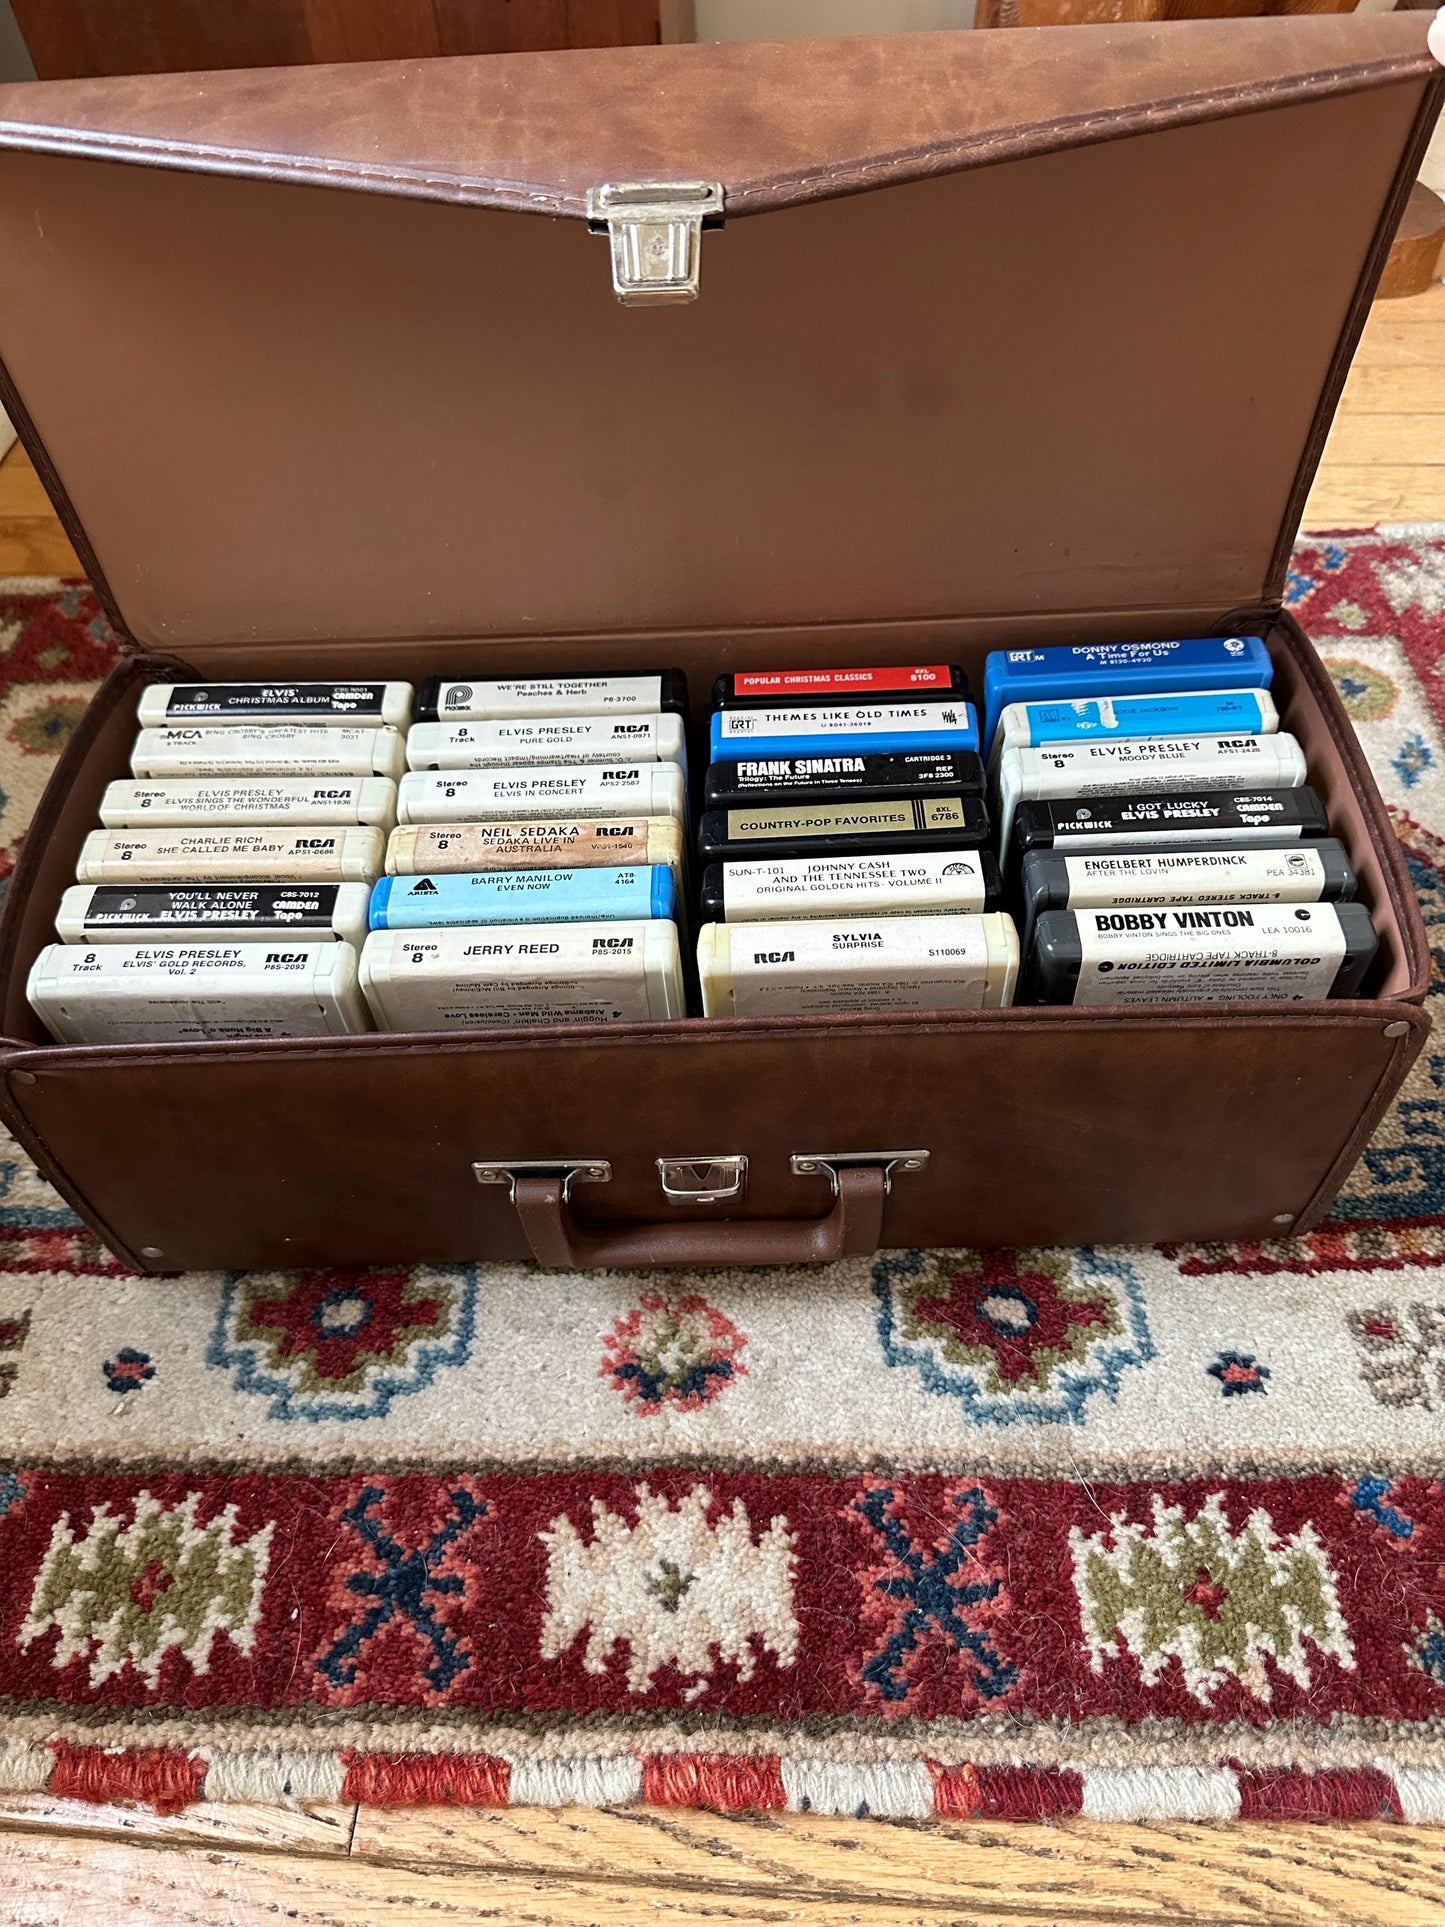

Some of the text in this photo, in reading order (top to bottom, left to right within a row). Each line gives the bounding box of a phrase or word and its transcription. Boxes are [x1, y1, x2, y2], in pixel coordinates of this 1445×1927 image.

[1072, 642, 1180, 654] DONNY OSMOND
[1131, 650, 1150, 658] For
[744, 673, 873, 685] POPULAR CHRISTMAS CLASSICS
[910, 673, 936, 681] 8100
[229, 696, 289, 704] CHRISTMAS
[332, 701, 357, 710] Tape
[765, 709, 927, 722] THEMES LIKE OLD TIMES
[499, 726, 592, 736] ELVIS PRESLEY
[614, 725, 649, 733] RCA
[1217, 740, 1257, 748] RCA
[1090, 742, 1200, 756] ELVIS PRESLEY
[1042, 752, 1074, 760] Stereo
[1119, 754, 1156, 762] MOODY
[737, 758, 865, 776] FRANK SINATRA
[1054, 760, 1065, 768] 8
[602, 770, 639, 779] RCA
[493, 779, 587, 789] ELVIS PRESLEY
[233, 789, 283, 797] PRESLEY
[314, 790, 351, 799] RCA
[446, 788, 455, 797] 8
[141, 799, 152, 807] 8
[1236, 803, 1284, 812] CAMDEN
[931, 812, 959, 820] 6786
[1121, 808, 1220, 820] ELVIS PRESLEY
[740, 814, 906, 830] COUNTRY-POP FAVORITES
[1240, 814, 1270, 826] Tape
[1058, 821, 1112, 830] PICKWICK
[481, 826, 580, 837] NEIL SEDAKA
[596, 826, 633, 836] RCA
[181, 837, 232, 845] CHARLIE
[295, 839, 334, 848] RCA
[438, 840, 448, 849] 8
[483, 837, 530, 845] SEDAKA
[496, 845, 561, 853] AUSTRALIA
[121, 851, 132, 860] 8
[808, 862, 890, 873] JOHNNY CASH
[1084, 856, 1247, 870] ENGELBERT HUMPERDINCK
[729, 868, 784, 876] SUN-T-101
[1288, 868, 1315, 876] 34381
[471, 873, 573, 885] BARRY MANILOW
[772, 876, 798, 884] AND
[828, 871, 896, 880] TENNESSEE
[497, 884, 523, 892] EVEN
[756, 884, 808, 893] ORIGINAL
[888, 878, 932, 886] VOLUME
[169, 892, 213, 900] YOU'LL
[172, 901, 252, 909] WALK ALONE
[272, 900, 319, 909] CAMDEN
[160, 910, 259, 920] ELVIS PRESLEY
[274, 911, 303, 922] Tape
[1095, 911, 1254, 930] BOBBY VINTON
[1283, 926, 1312, 934] 10016
[833, 933, 882, 941] SYLVIA
[593, 938, 633, 947] RCA
[832, 941, 884, 949] SURPRISE
[463, 944, 560, 955] JERRY REED
[929, 948, 965, 956] S110069
[1235, 950, 1277, 958] 8-TRACK
[84, 954, 96, 963] 8
[136, 950, 241, 959] ELVIS PRESLEY
[265, 954, 308, 962] RCA
[412, 953, 423, 963] 8
[754, 951, 795, 964] RCA
[73, 964, 102, 972] Track
[1118, 961, 1176, 969] EDITION
